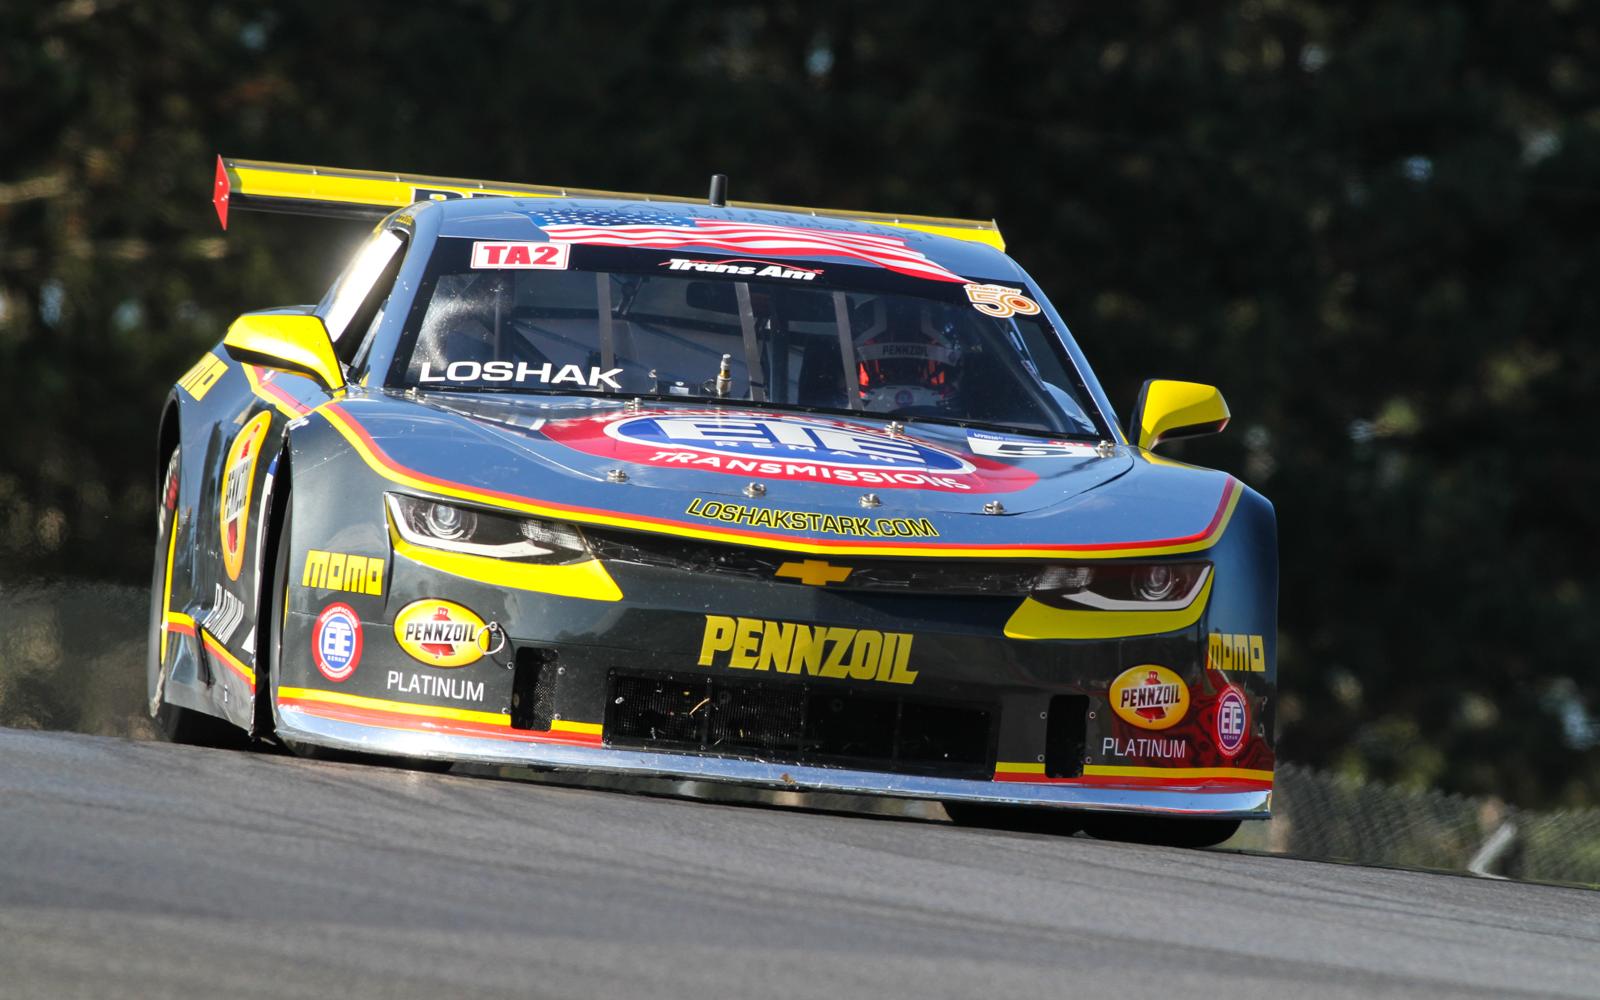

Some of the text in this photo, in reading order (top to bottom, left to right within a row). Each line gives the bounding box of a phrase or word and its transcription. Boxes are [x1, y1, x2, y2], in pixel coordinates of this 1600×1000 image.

[483, 245, 560, 265] TA2
[669, 258, 816, 281] Trans Am
[966, 289, 1041, 318] 50
[419, 361, 624, 389] LOSHAK
[652, 416, 926, 464] ETE
[714, 440, 896, 463] REMAN
[649, 450, 972, 490] TRANSMISSIONS
[686, 498, 940, 538] LOSHAKSTARK.COM
[405, 622, 477, 643] PENNZOIL
[697, 614, 919, 685] PENNZOIL
[387, 670, 485, 702] PLATINUM
[1120, 684, 1181, 708] PENNZOIL
[1102, 737, 1186, 759] PLATINUM
